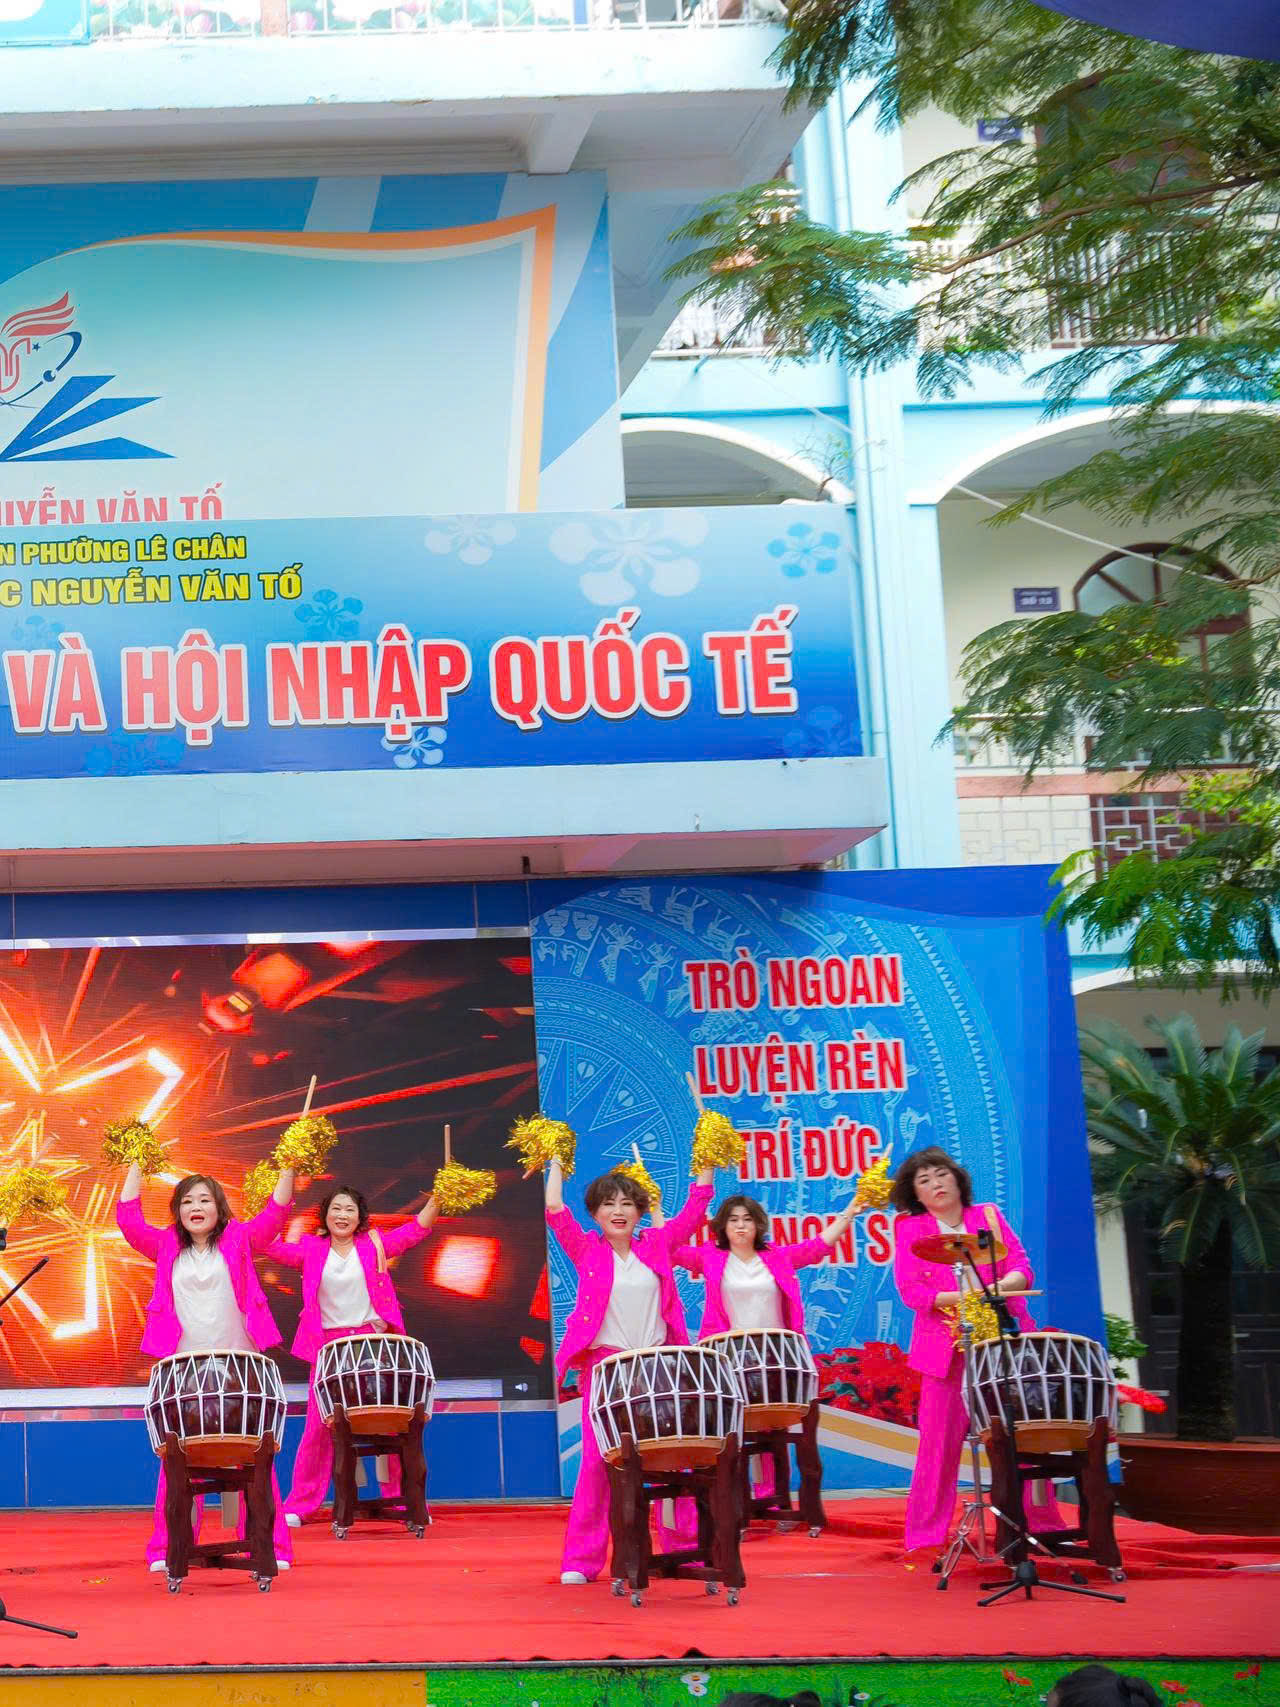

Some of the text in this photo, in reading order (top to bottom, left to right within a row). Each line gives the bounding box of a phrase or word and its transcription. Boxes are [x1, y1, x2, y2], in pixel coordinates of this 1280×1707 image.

[96, 489, 168, 523] VĂN
[21, 535, 131, 566] PHƯỜNG
[135, 534, 168, 562] LÊ
[172, 532, 248, 561] CHÂN
[31, 566, 171, 607] NGUYỄN
[178, 568, 251, 602] VĂN
[258, 562, 304, 601] TỐ
[4, 632, 107, 734] VÀ
[122, 629, 250, 747] HỘI
[266, 623, 471, 743] NHẬP
[489, 606, 692, 731] QUỐC
[703, 603, 800, 716] TẾ
[685, 948, 903, 1011] TRÒ NGOAN
[694, 1032, 905, 1105] LUYỆN RÈN
[803, 1118, 881, 1177] ĐỨC
